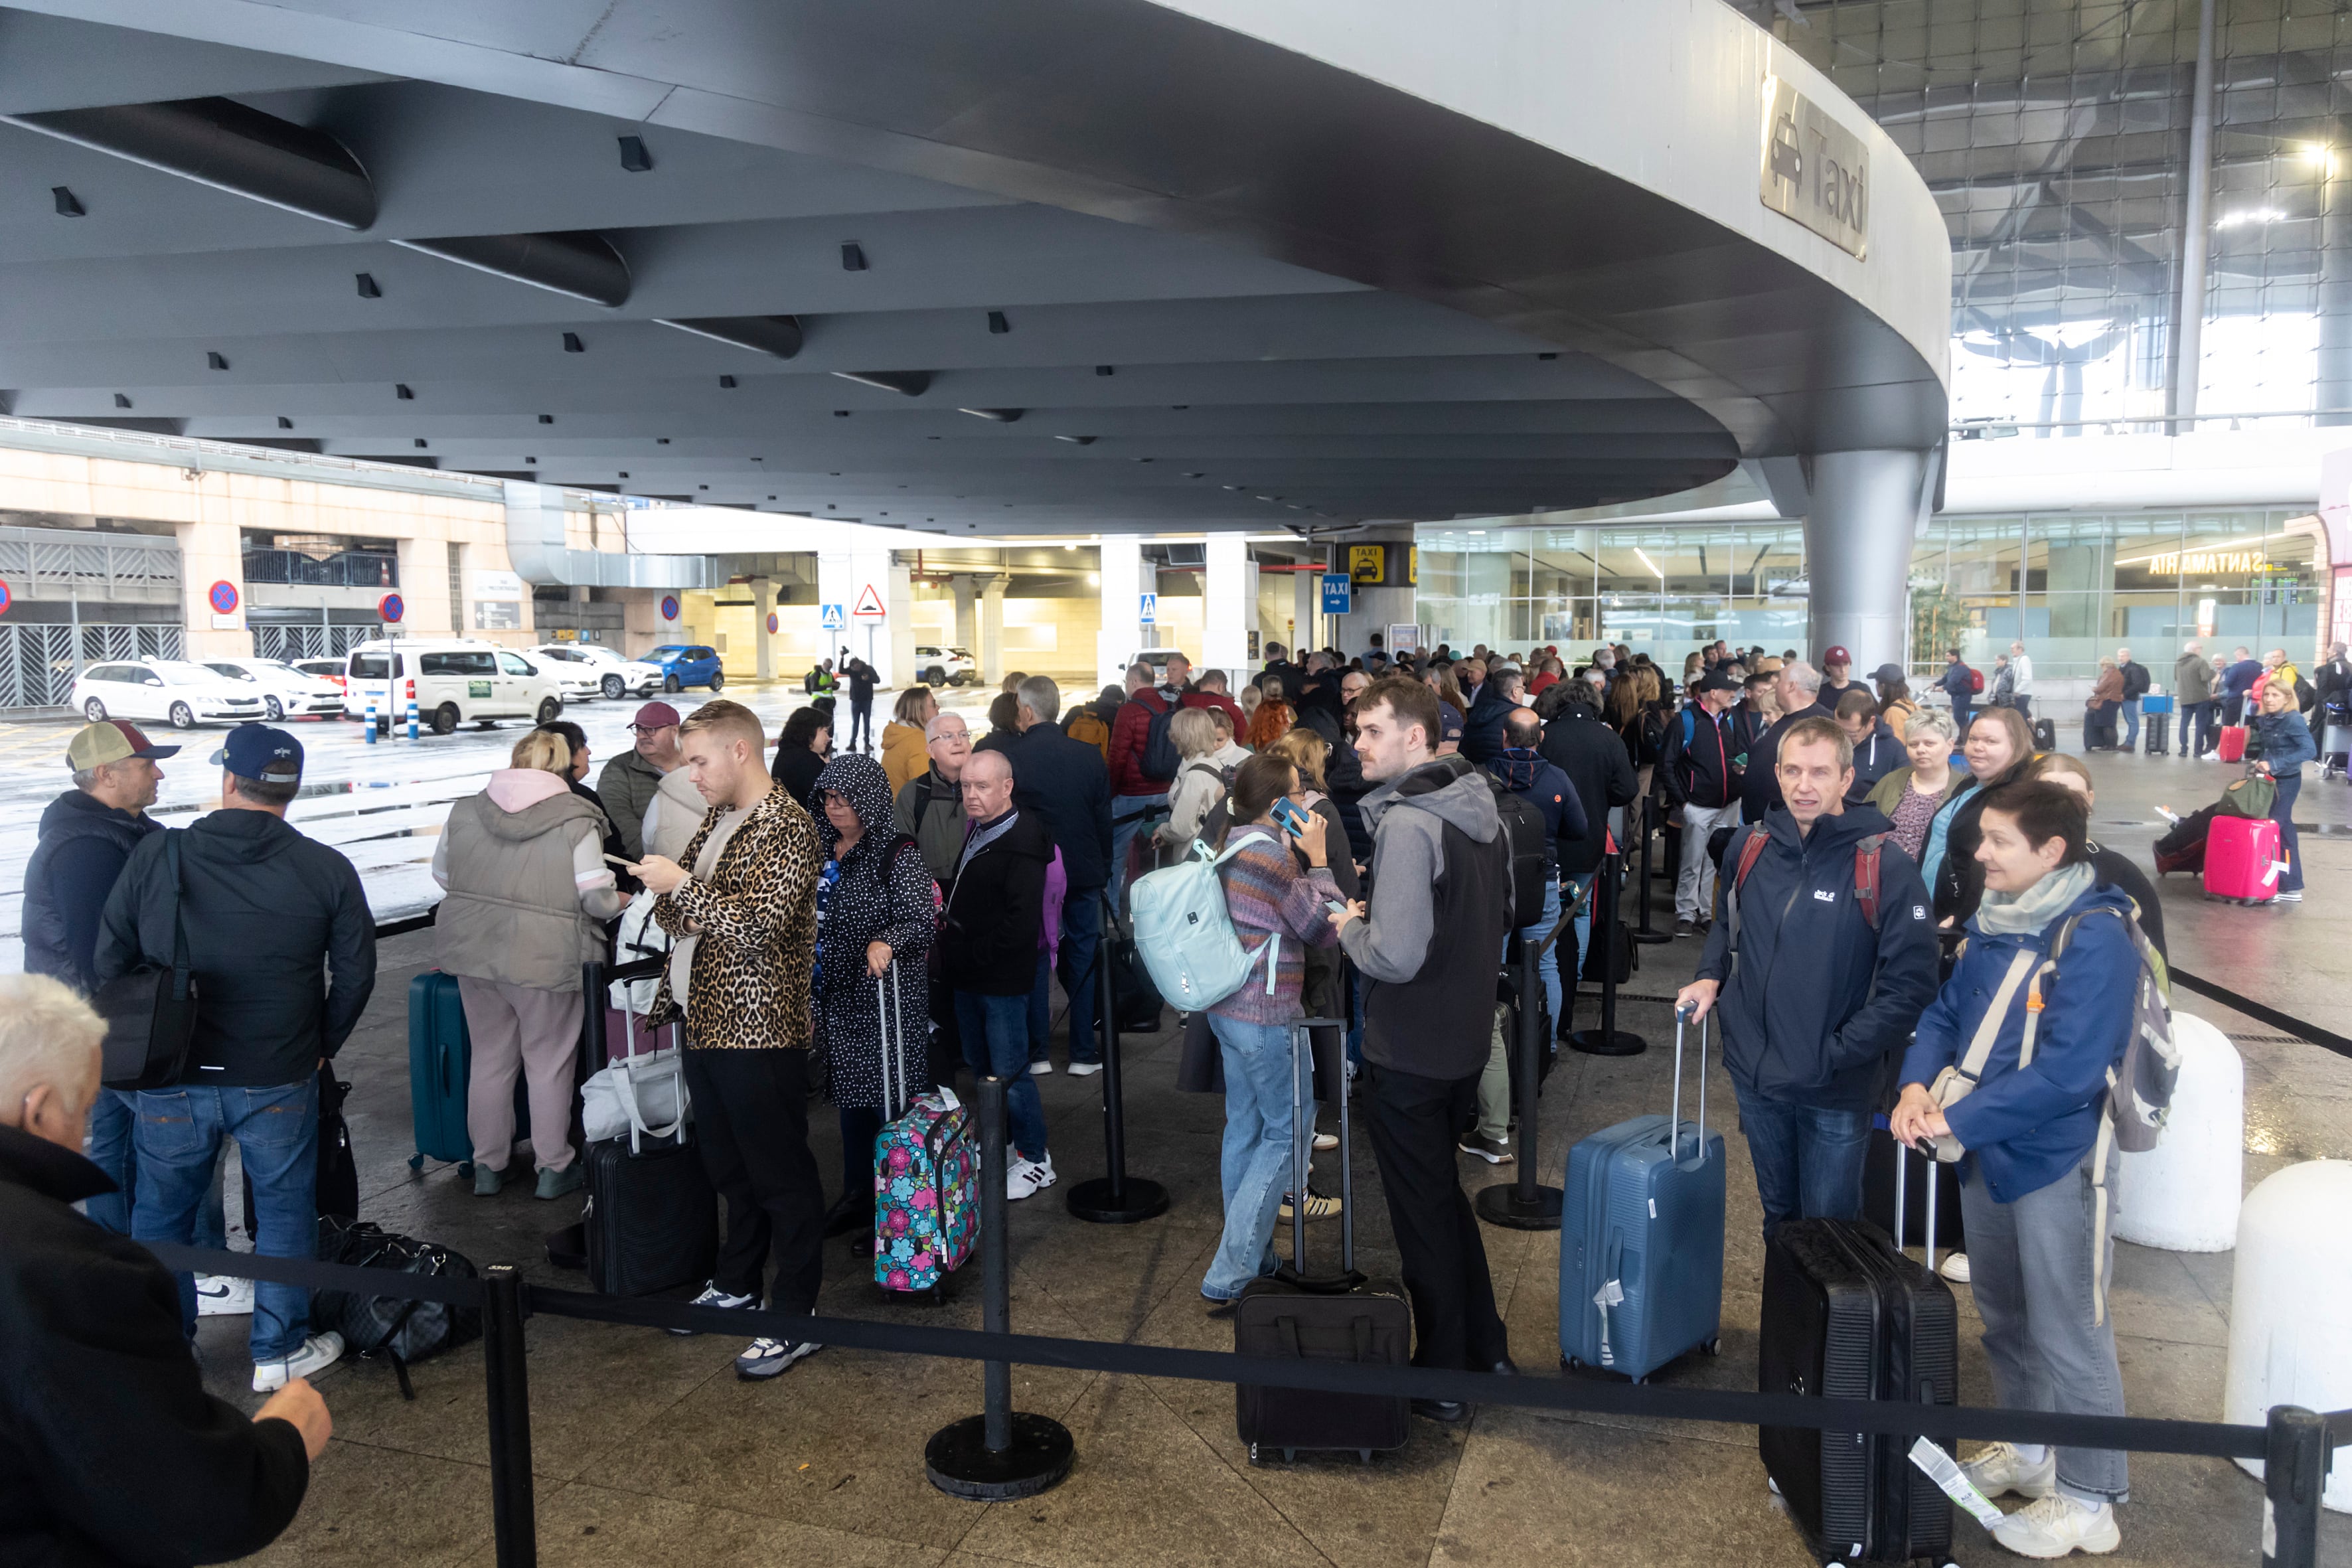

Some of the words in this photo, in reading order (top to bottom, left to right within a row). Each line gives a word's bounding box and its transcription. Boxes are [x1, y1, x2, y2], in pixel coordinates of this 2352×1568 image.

[1810, 127, 1863, 234] Taxi
[1324, 583, 1348, 595] TAXI
[1961, 1492, 1972, 1501] AGP
